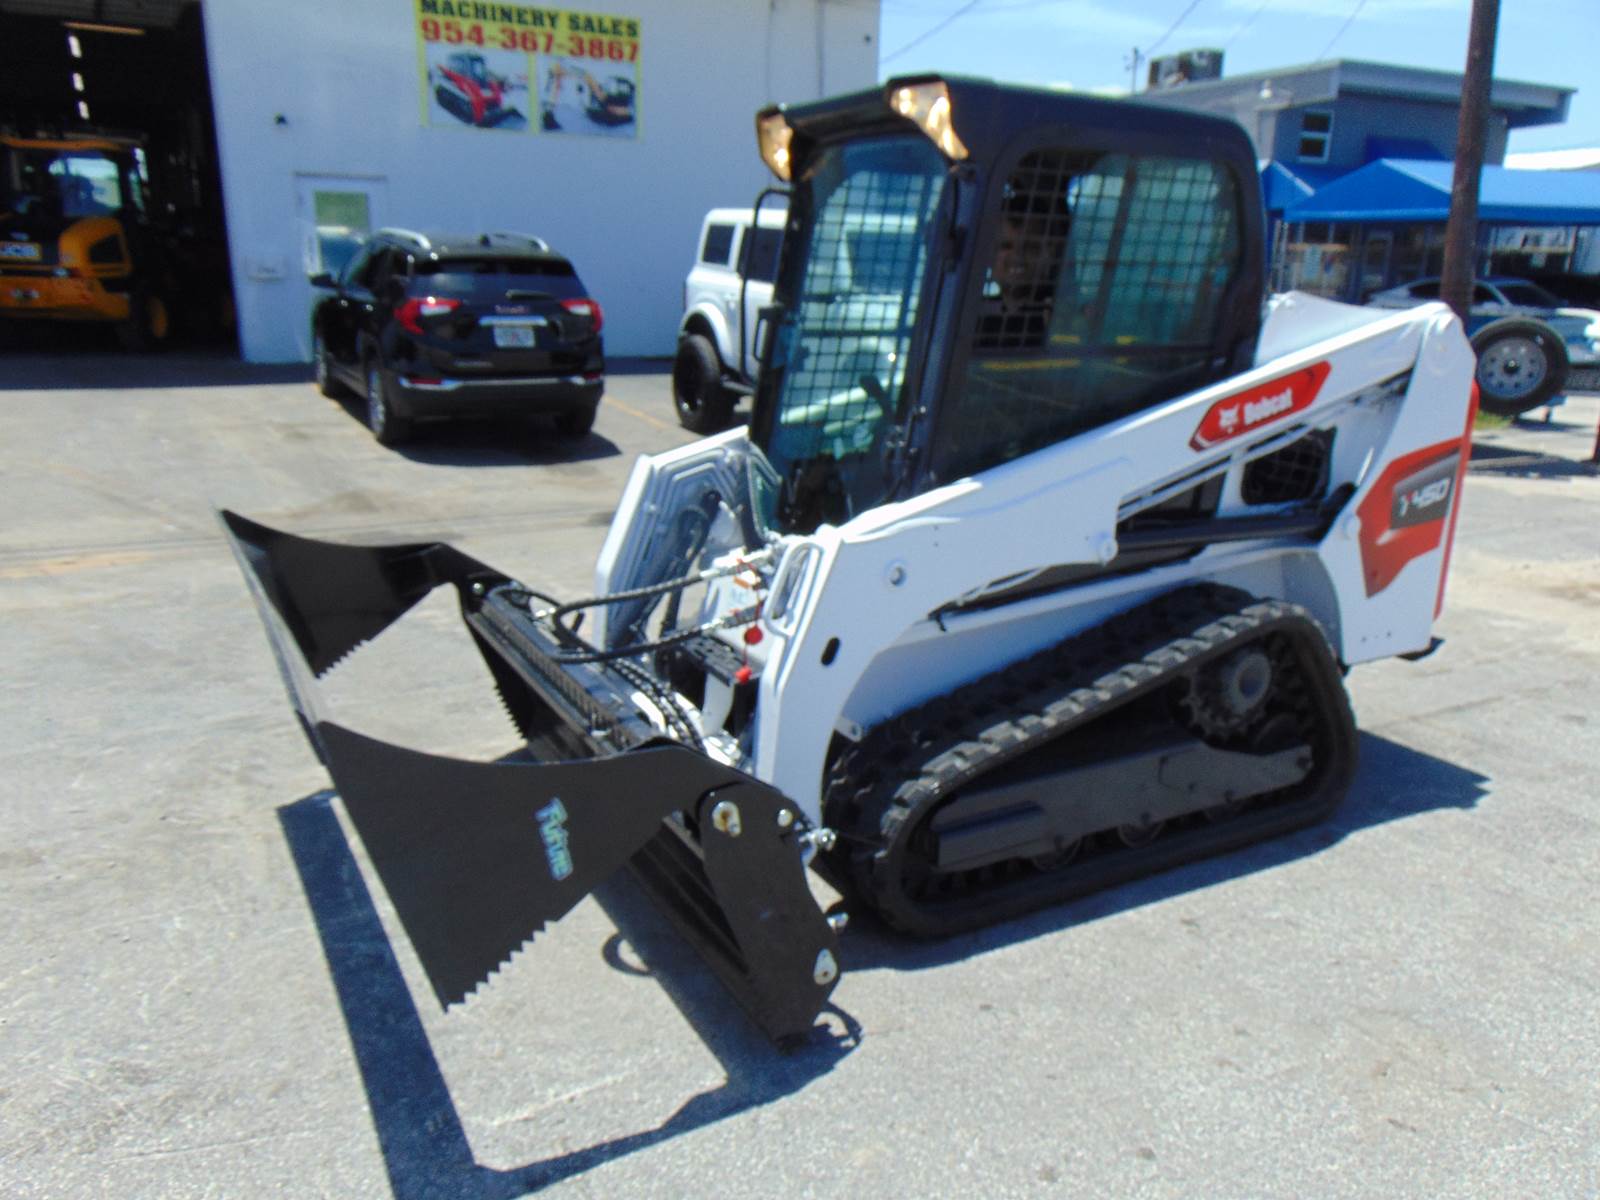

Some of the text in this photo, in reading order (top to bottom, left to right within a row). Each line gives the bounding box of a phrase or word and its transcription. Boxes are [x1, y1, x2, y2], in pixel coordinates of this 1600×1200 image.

[421, 0, 639, 37] MACHINERY SALES
[421, 17, 639, 63] 954-367-3867
[1243, 387, 1294, 426] Bobcat
